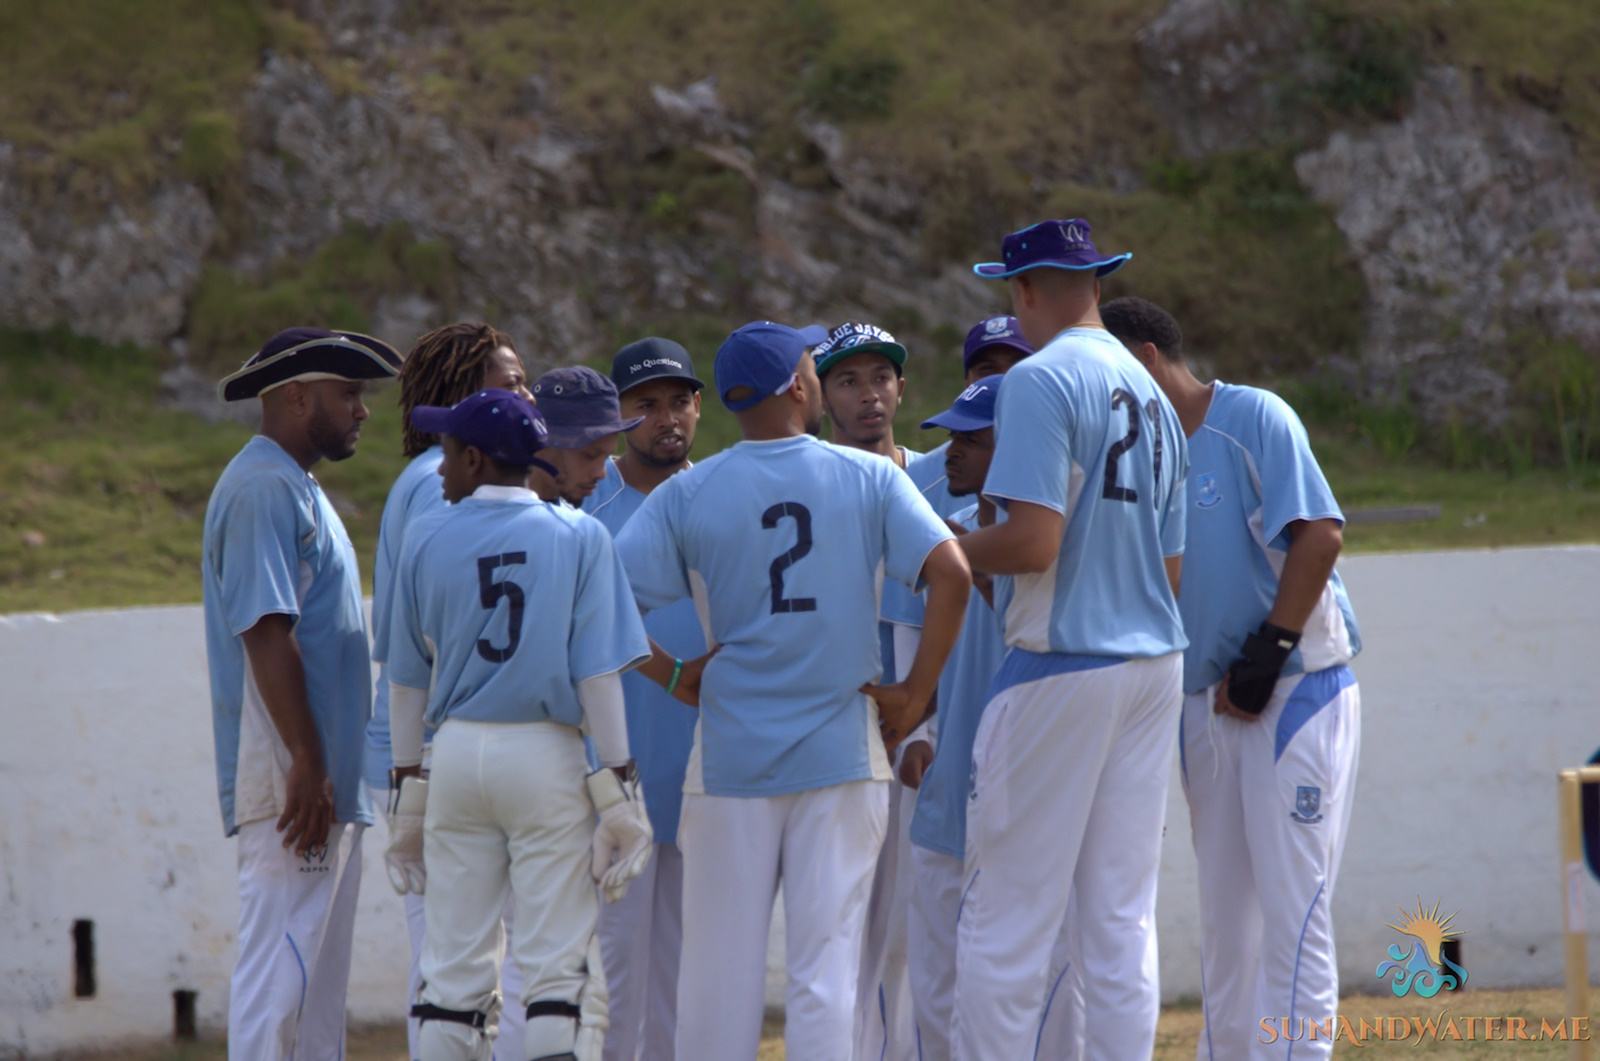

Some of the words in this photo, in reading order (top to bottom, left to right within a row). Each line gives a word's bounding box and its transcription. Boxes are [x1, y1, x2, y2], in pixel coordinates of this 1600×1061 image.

[629, 364, 642, 374] No
[643, 358, 682, 369] Questions
[817, 323, 853, 352] BLUE
[854, 323, 894, 342] JAYS
[1102, 387, 1163, 511] 21
[476, 551, 527, 663] 5
[761, 501, 817, 615] 2
